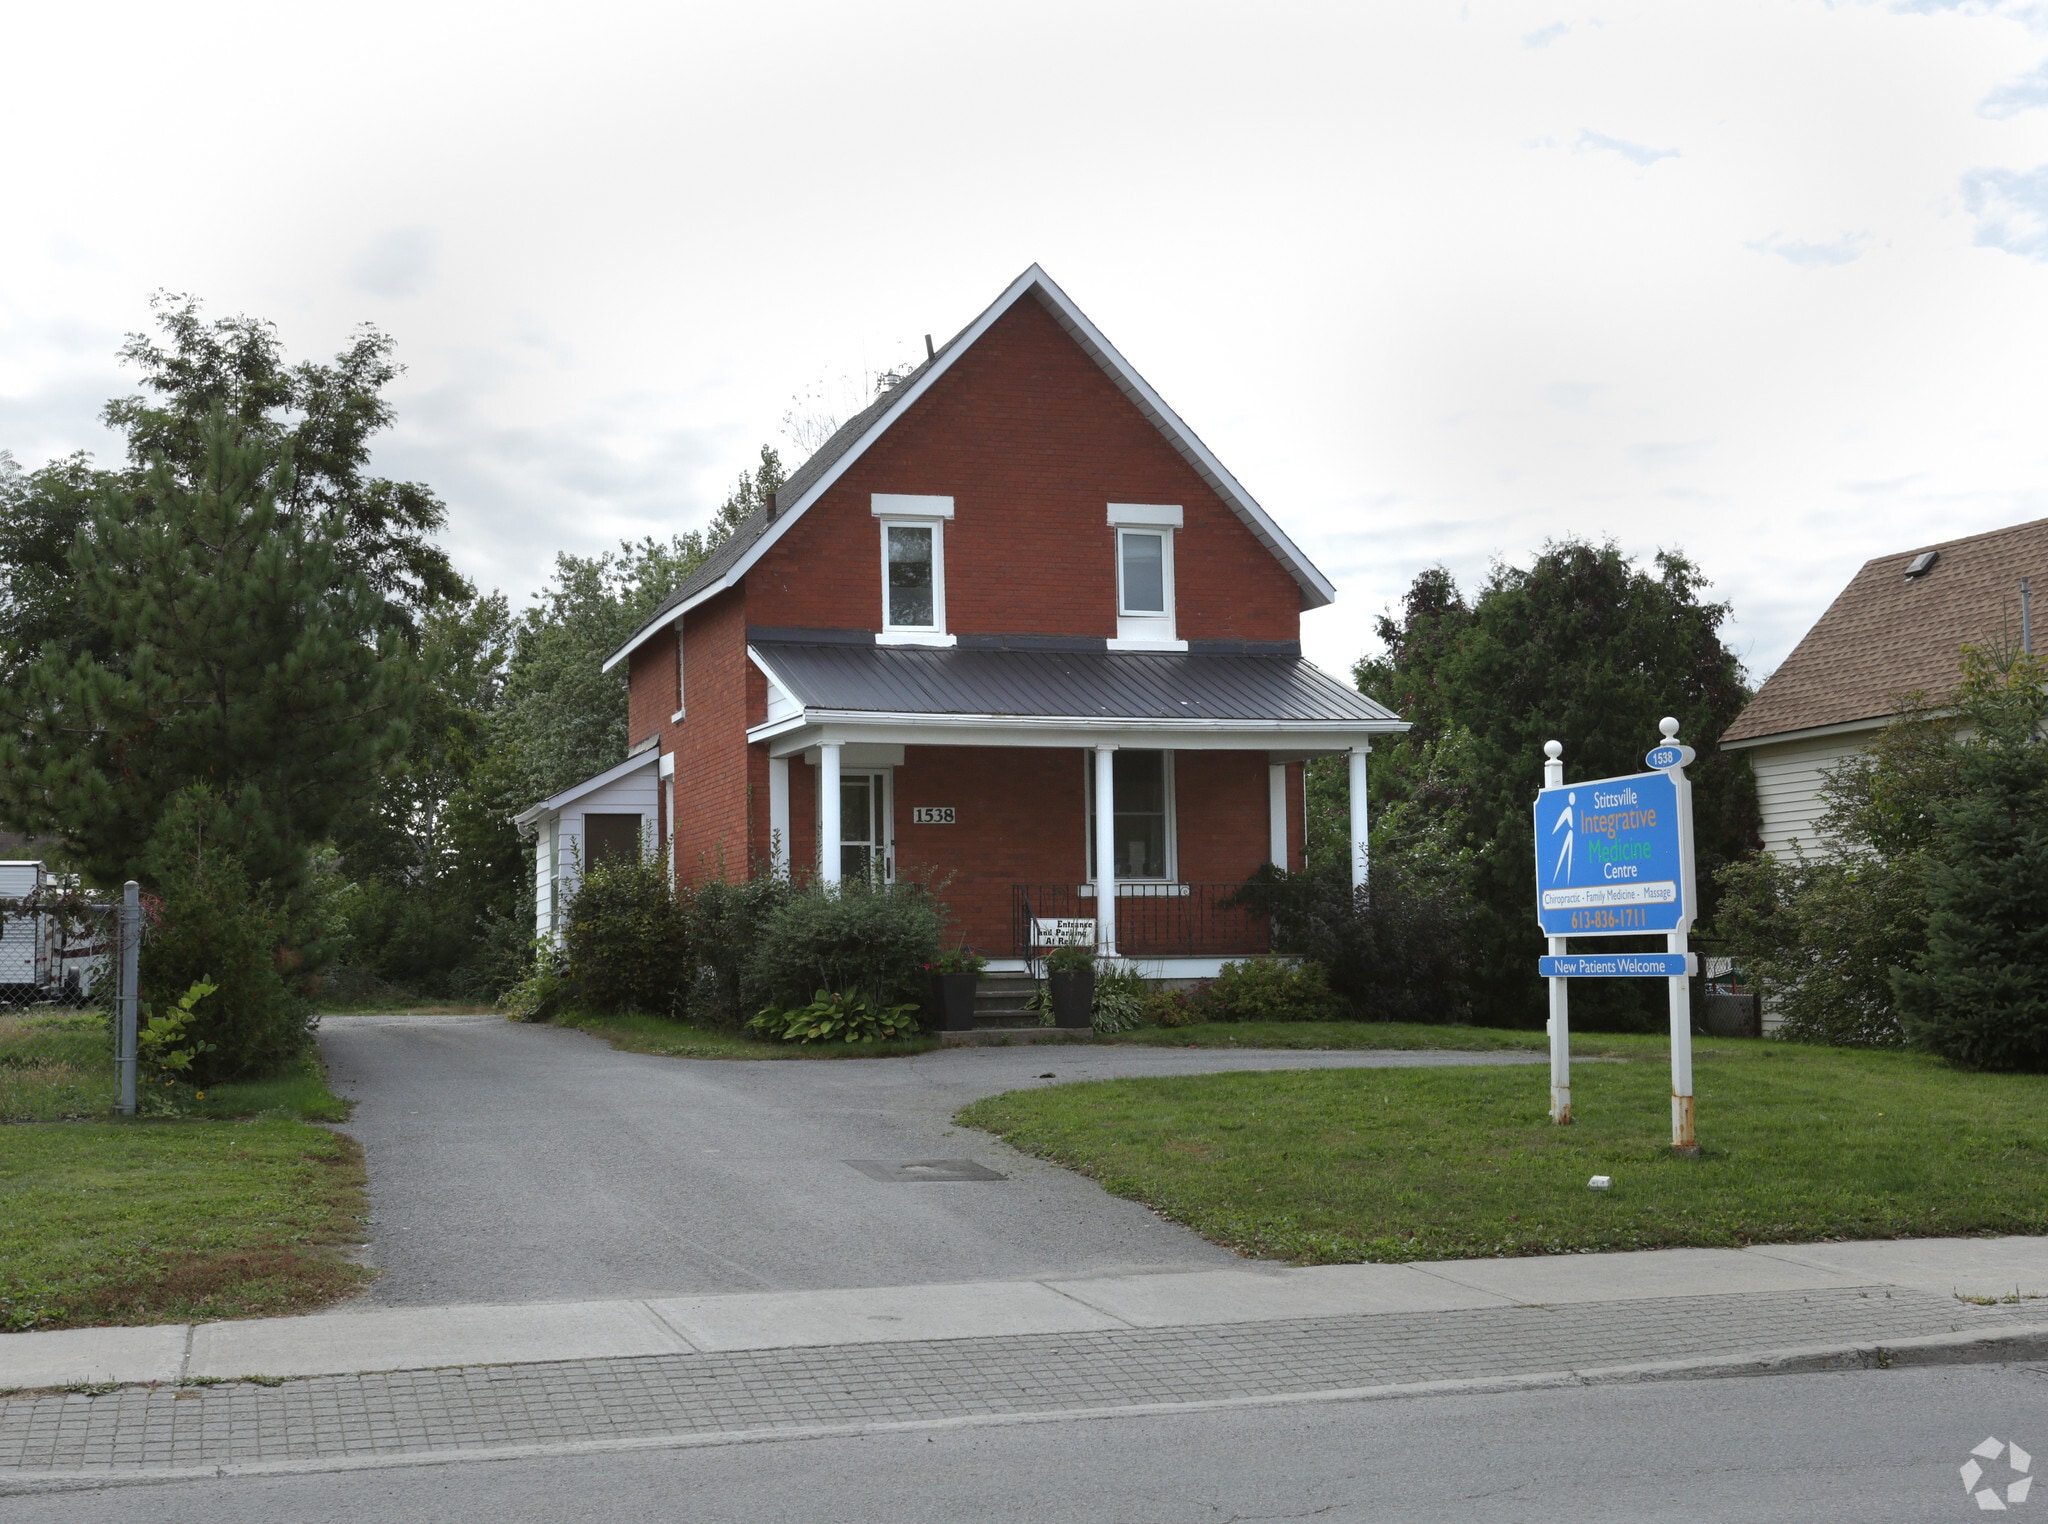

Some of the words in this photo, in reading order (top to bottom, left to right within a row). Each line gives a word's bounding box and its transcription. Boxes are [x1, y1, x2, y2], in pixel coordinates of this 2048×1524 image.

[1652, 751, 1673, 765] 1538
[1594, 788, 1638, 809] Stittsville
[916, 808, 954, 823] 1538
[1581, 806, 1657, 839] Integrative
[1588, 837, 1652, 864] Medicine
[1603, 863, 1638, 879] Centre
[1545, 892, 1581, 906] Chiropractic
[1586, 890, 1605, 904] Family
[1606, 889, 1636, 902] Medicine
[1643, 887, 1671, 900] Massage
[1571, 909, 1646, 929] 613-836-1711
[1046, 937, 1055, 945] At
[1554, 960, 1577, 973] New
[1579, 959, 1616, 973] Patients
[1617, 959, 1666, 973] Welcome
